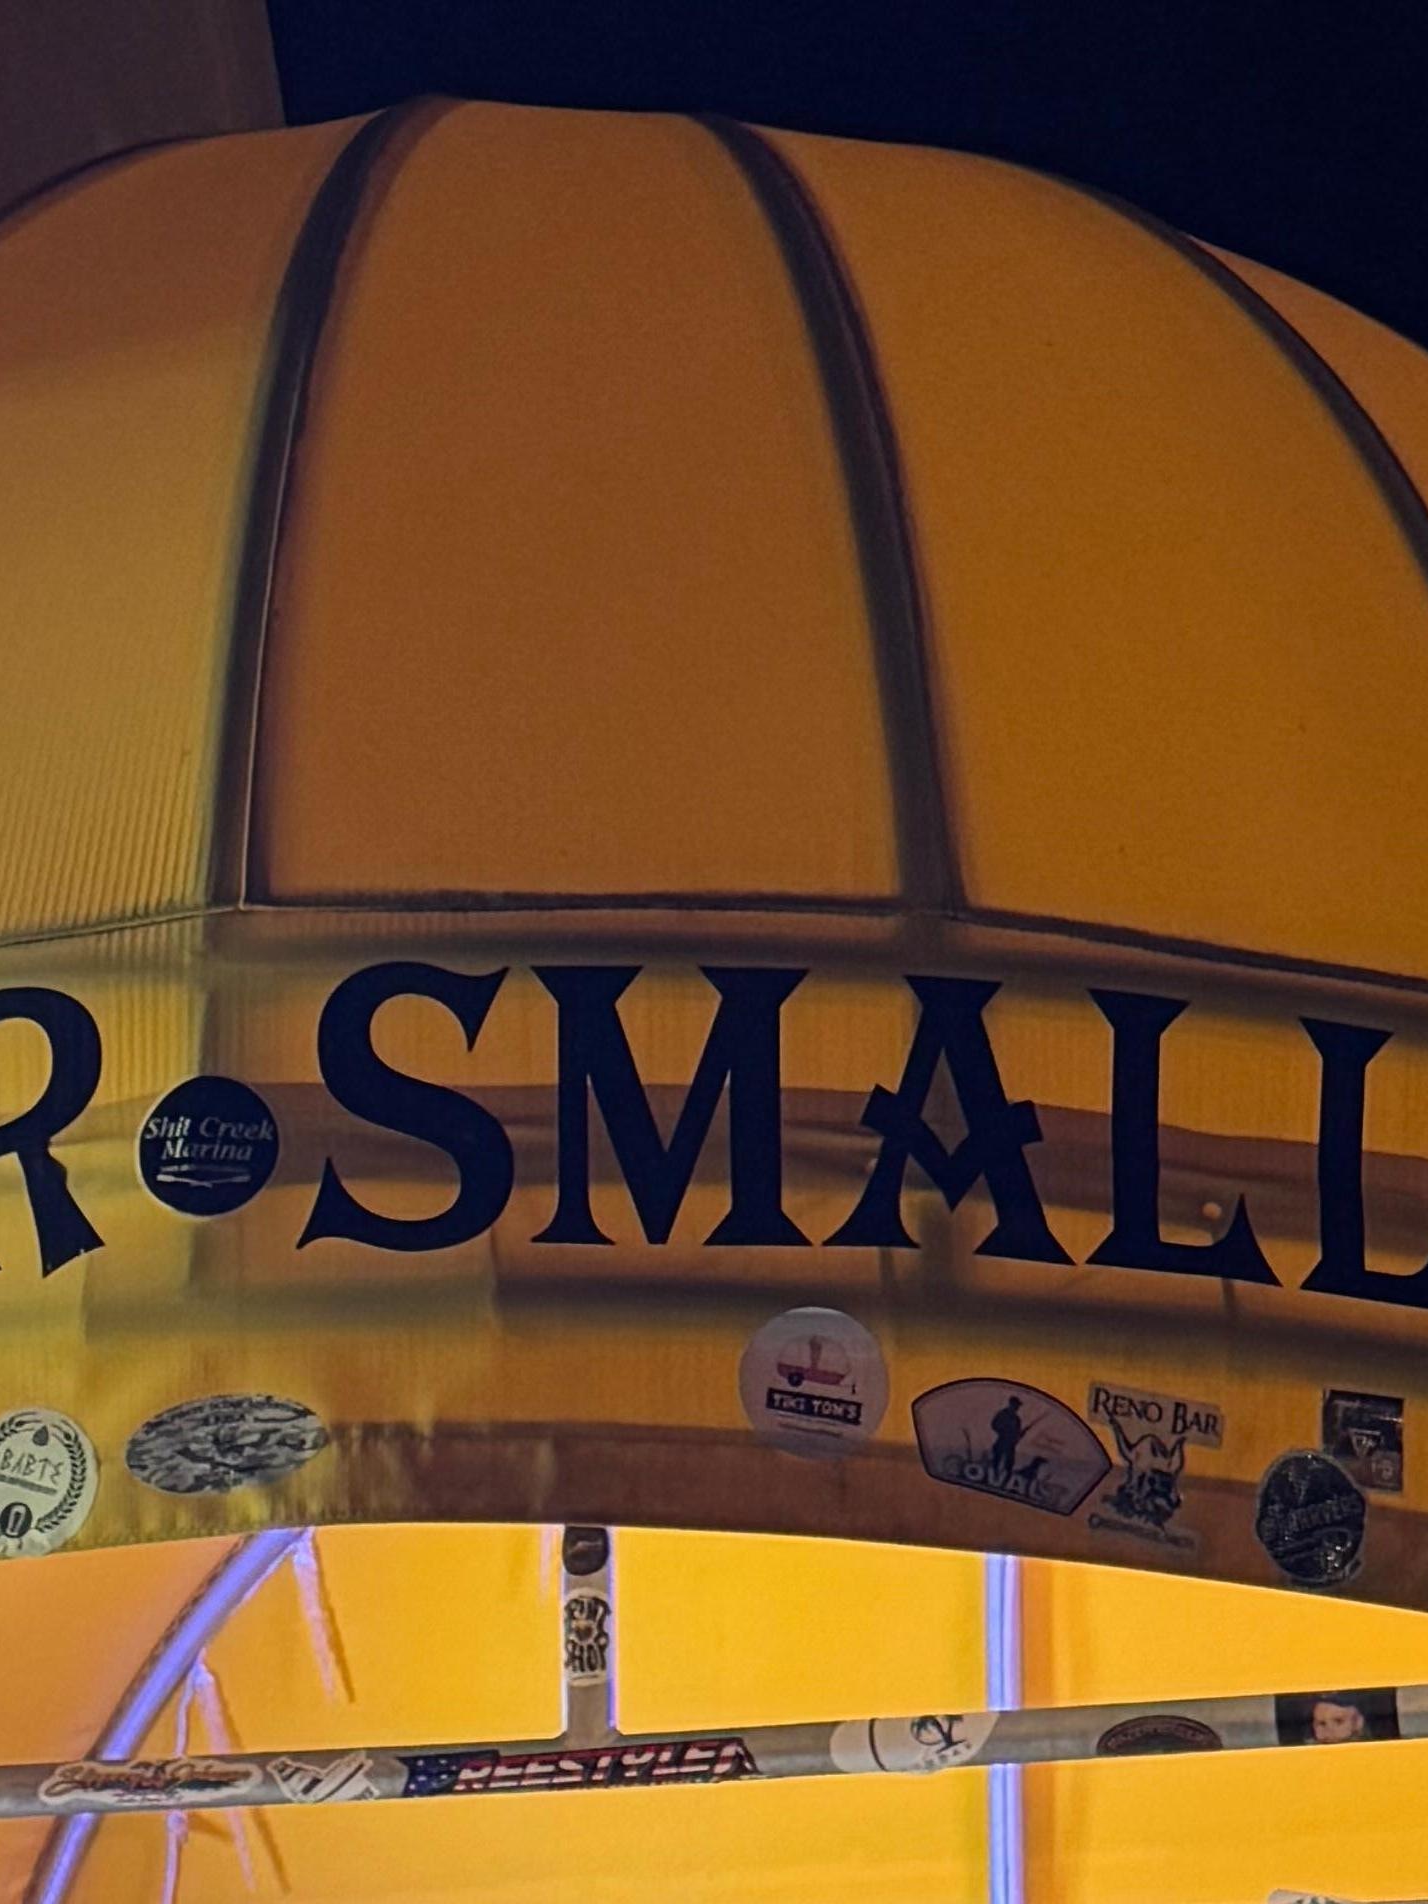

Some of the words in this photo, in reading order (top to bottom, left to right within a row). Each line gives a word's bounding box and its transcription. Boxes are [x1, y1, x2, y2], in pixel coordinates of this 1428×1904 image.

[161, 1138, 253, 1161] Marina
[1094, 1387, 1164, 1424] RENO
[1172, 1401, 1221, 1436] BAR
